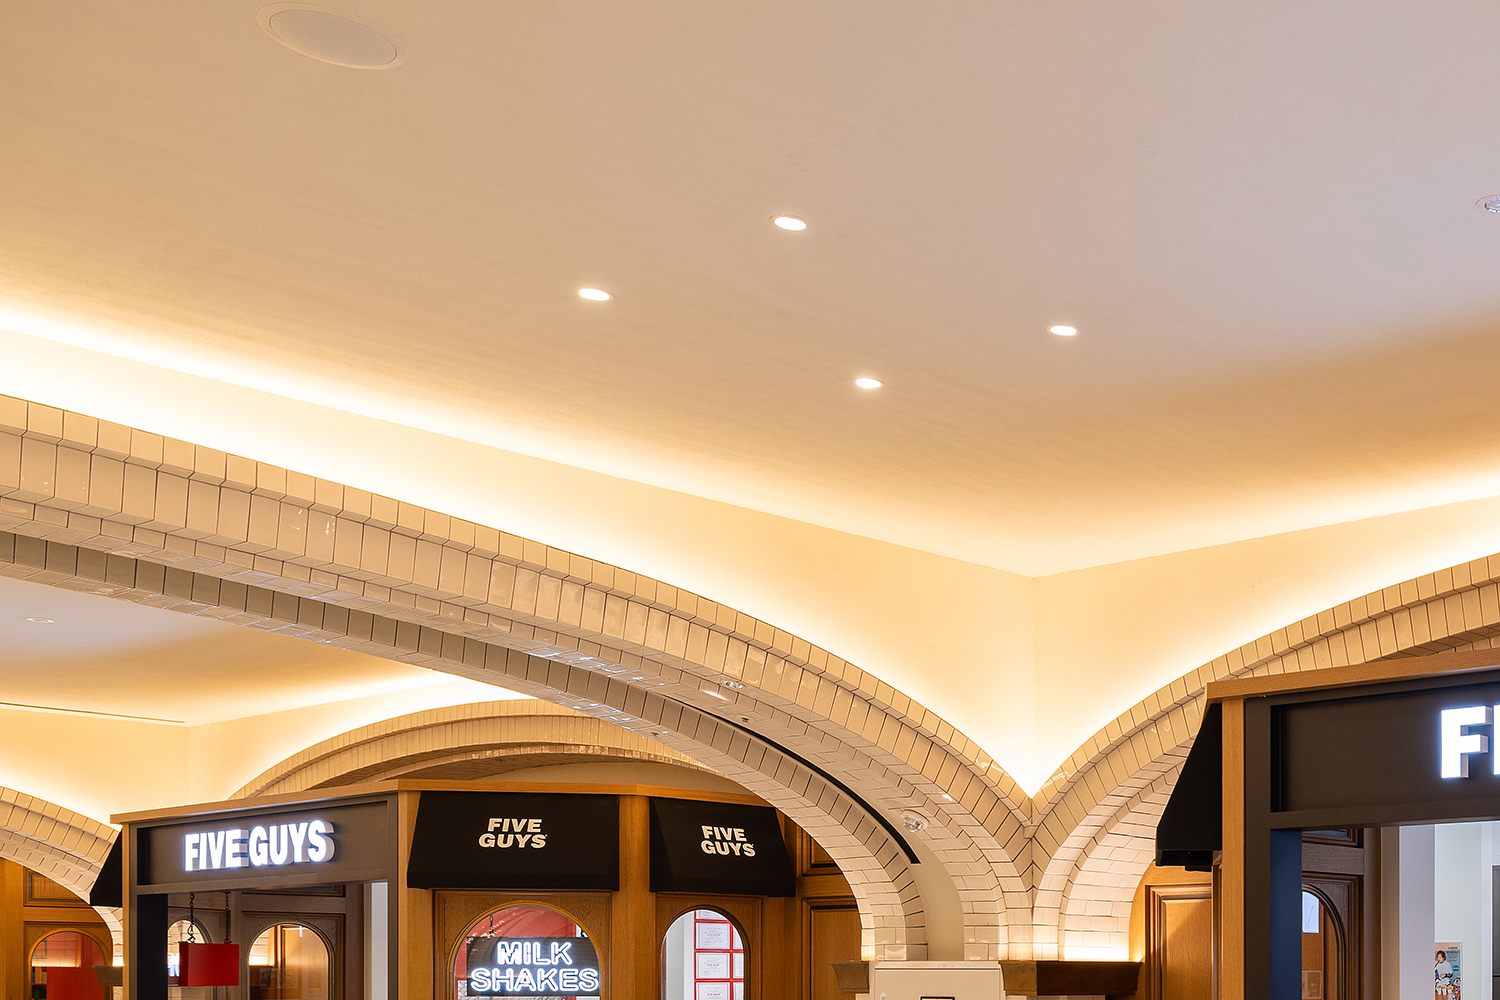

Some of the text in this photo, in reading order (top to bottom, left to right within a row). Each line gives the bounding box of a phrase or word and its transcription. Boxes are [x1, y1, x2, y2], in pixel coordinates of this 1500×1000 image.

[487, 818, 542, 833] FIVE
[701, 825, 747, 842] FIVE
[185, 819, 333, 872] FIVE GUYS
[478, 834, 547, 848] GUYS
[701, 840, 756, 857] GUYS
[497, 941, 573, 966] MILK
[470, 967, 599, 992] SHAKES
